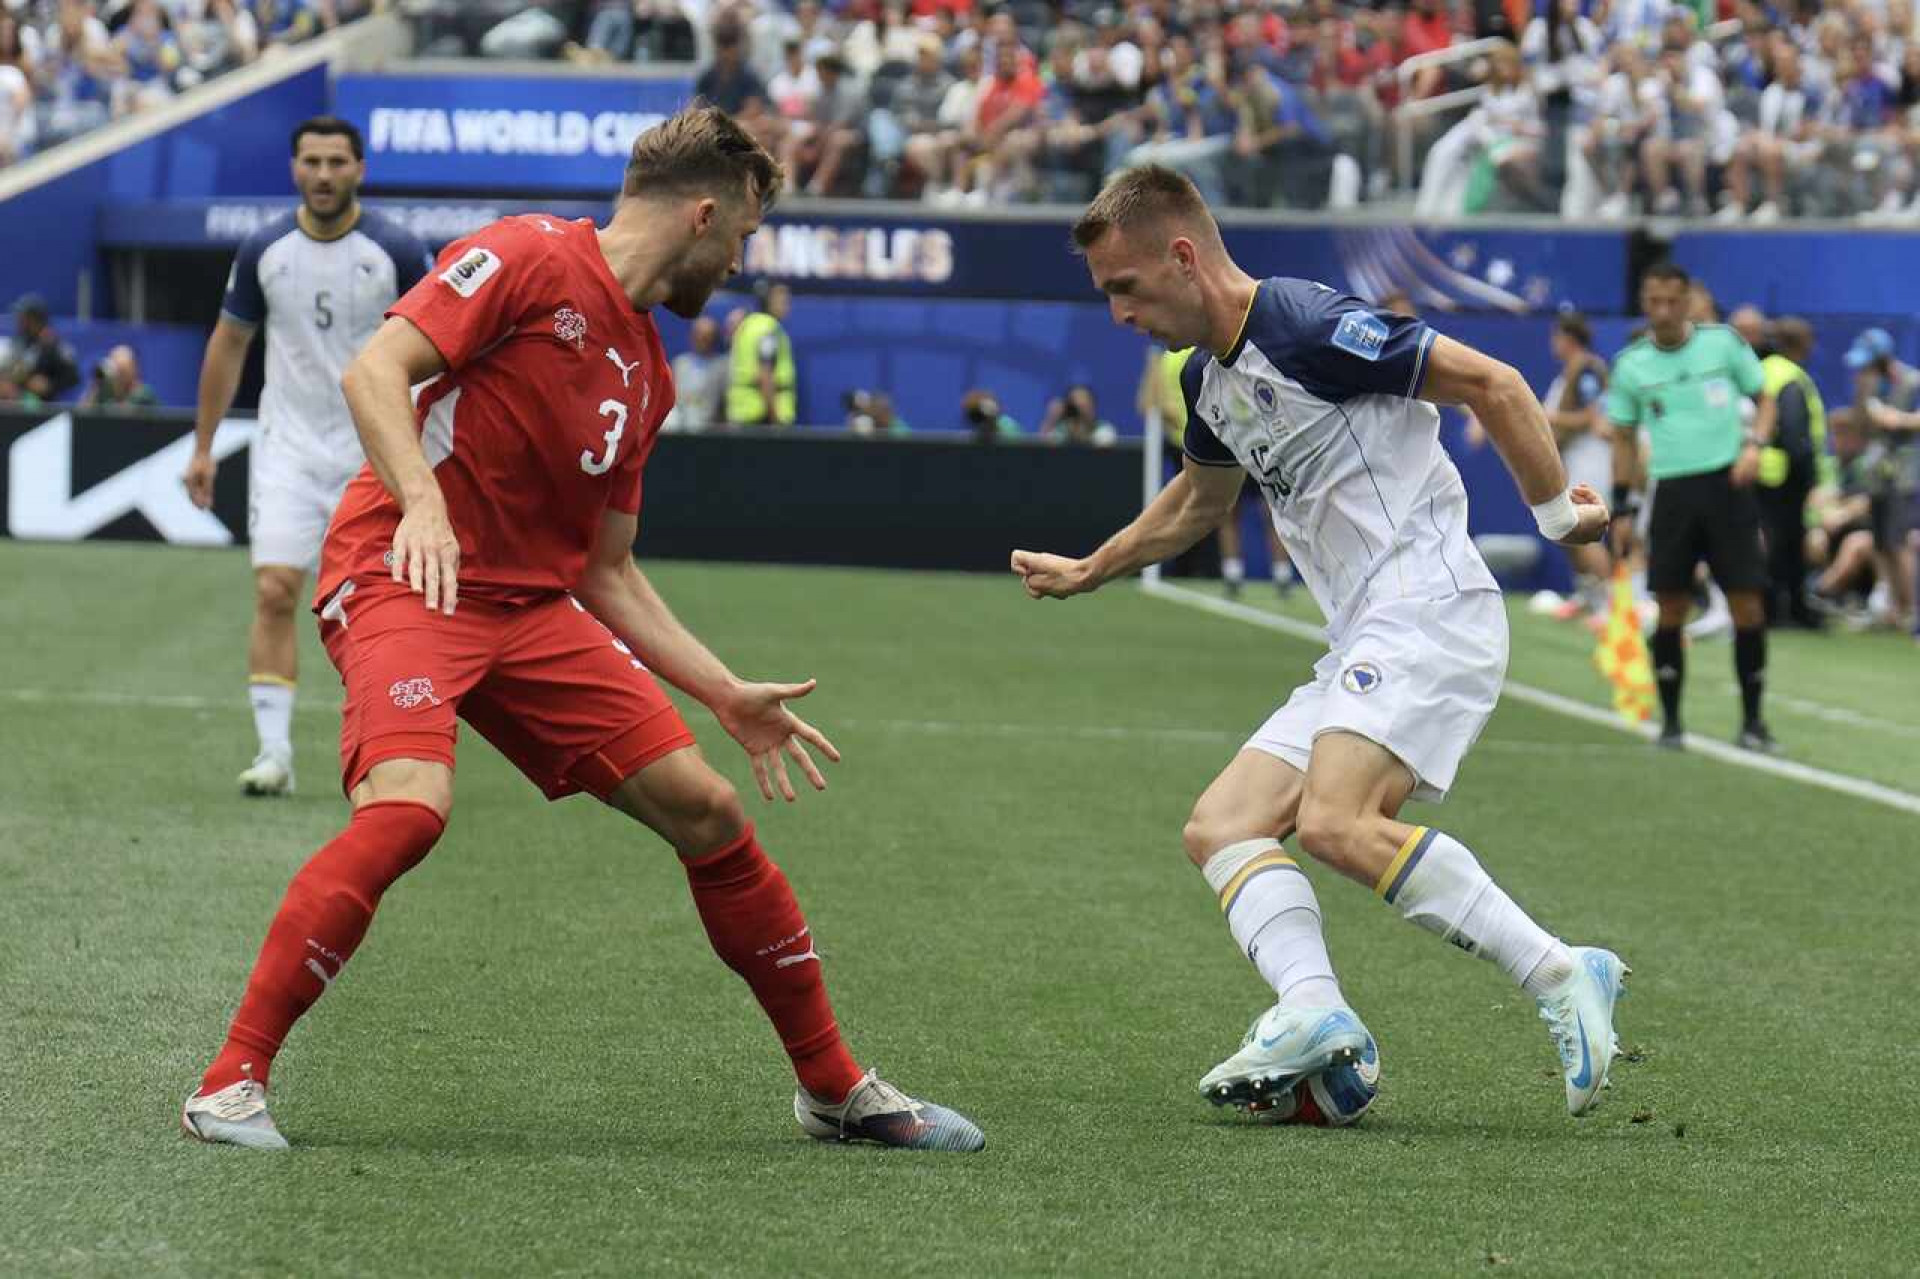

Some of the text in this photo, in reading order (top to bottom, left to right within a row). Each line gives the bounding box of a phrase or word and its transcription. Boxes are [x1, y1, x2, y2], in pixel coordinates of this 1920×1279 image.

[370, 108, 448, 153] FIFA
[453, 109, 588, 155] WORLD
[315, 290, 333, 330] 5
[580, 399, 627, 475] 3
